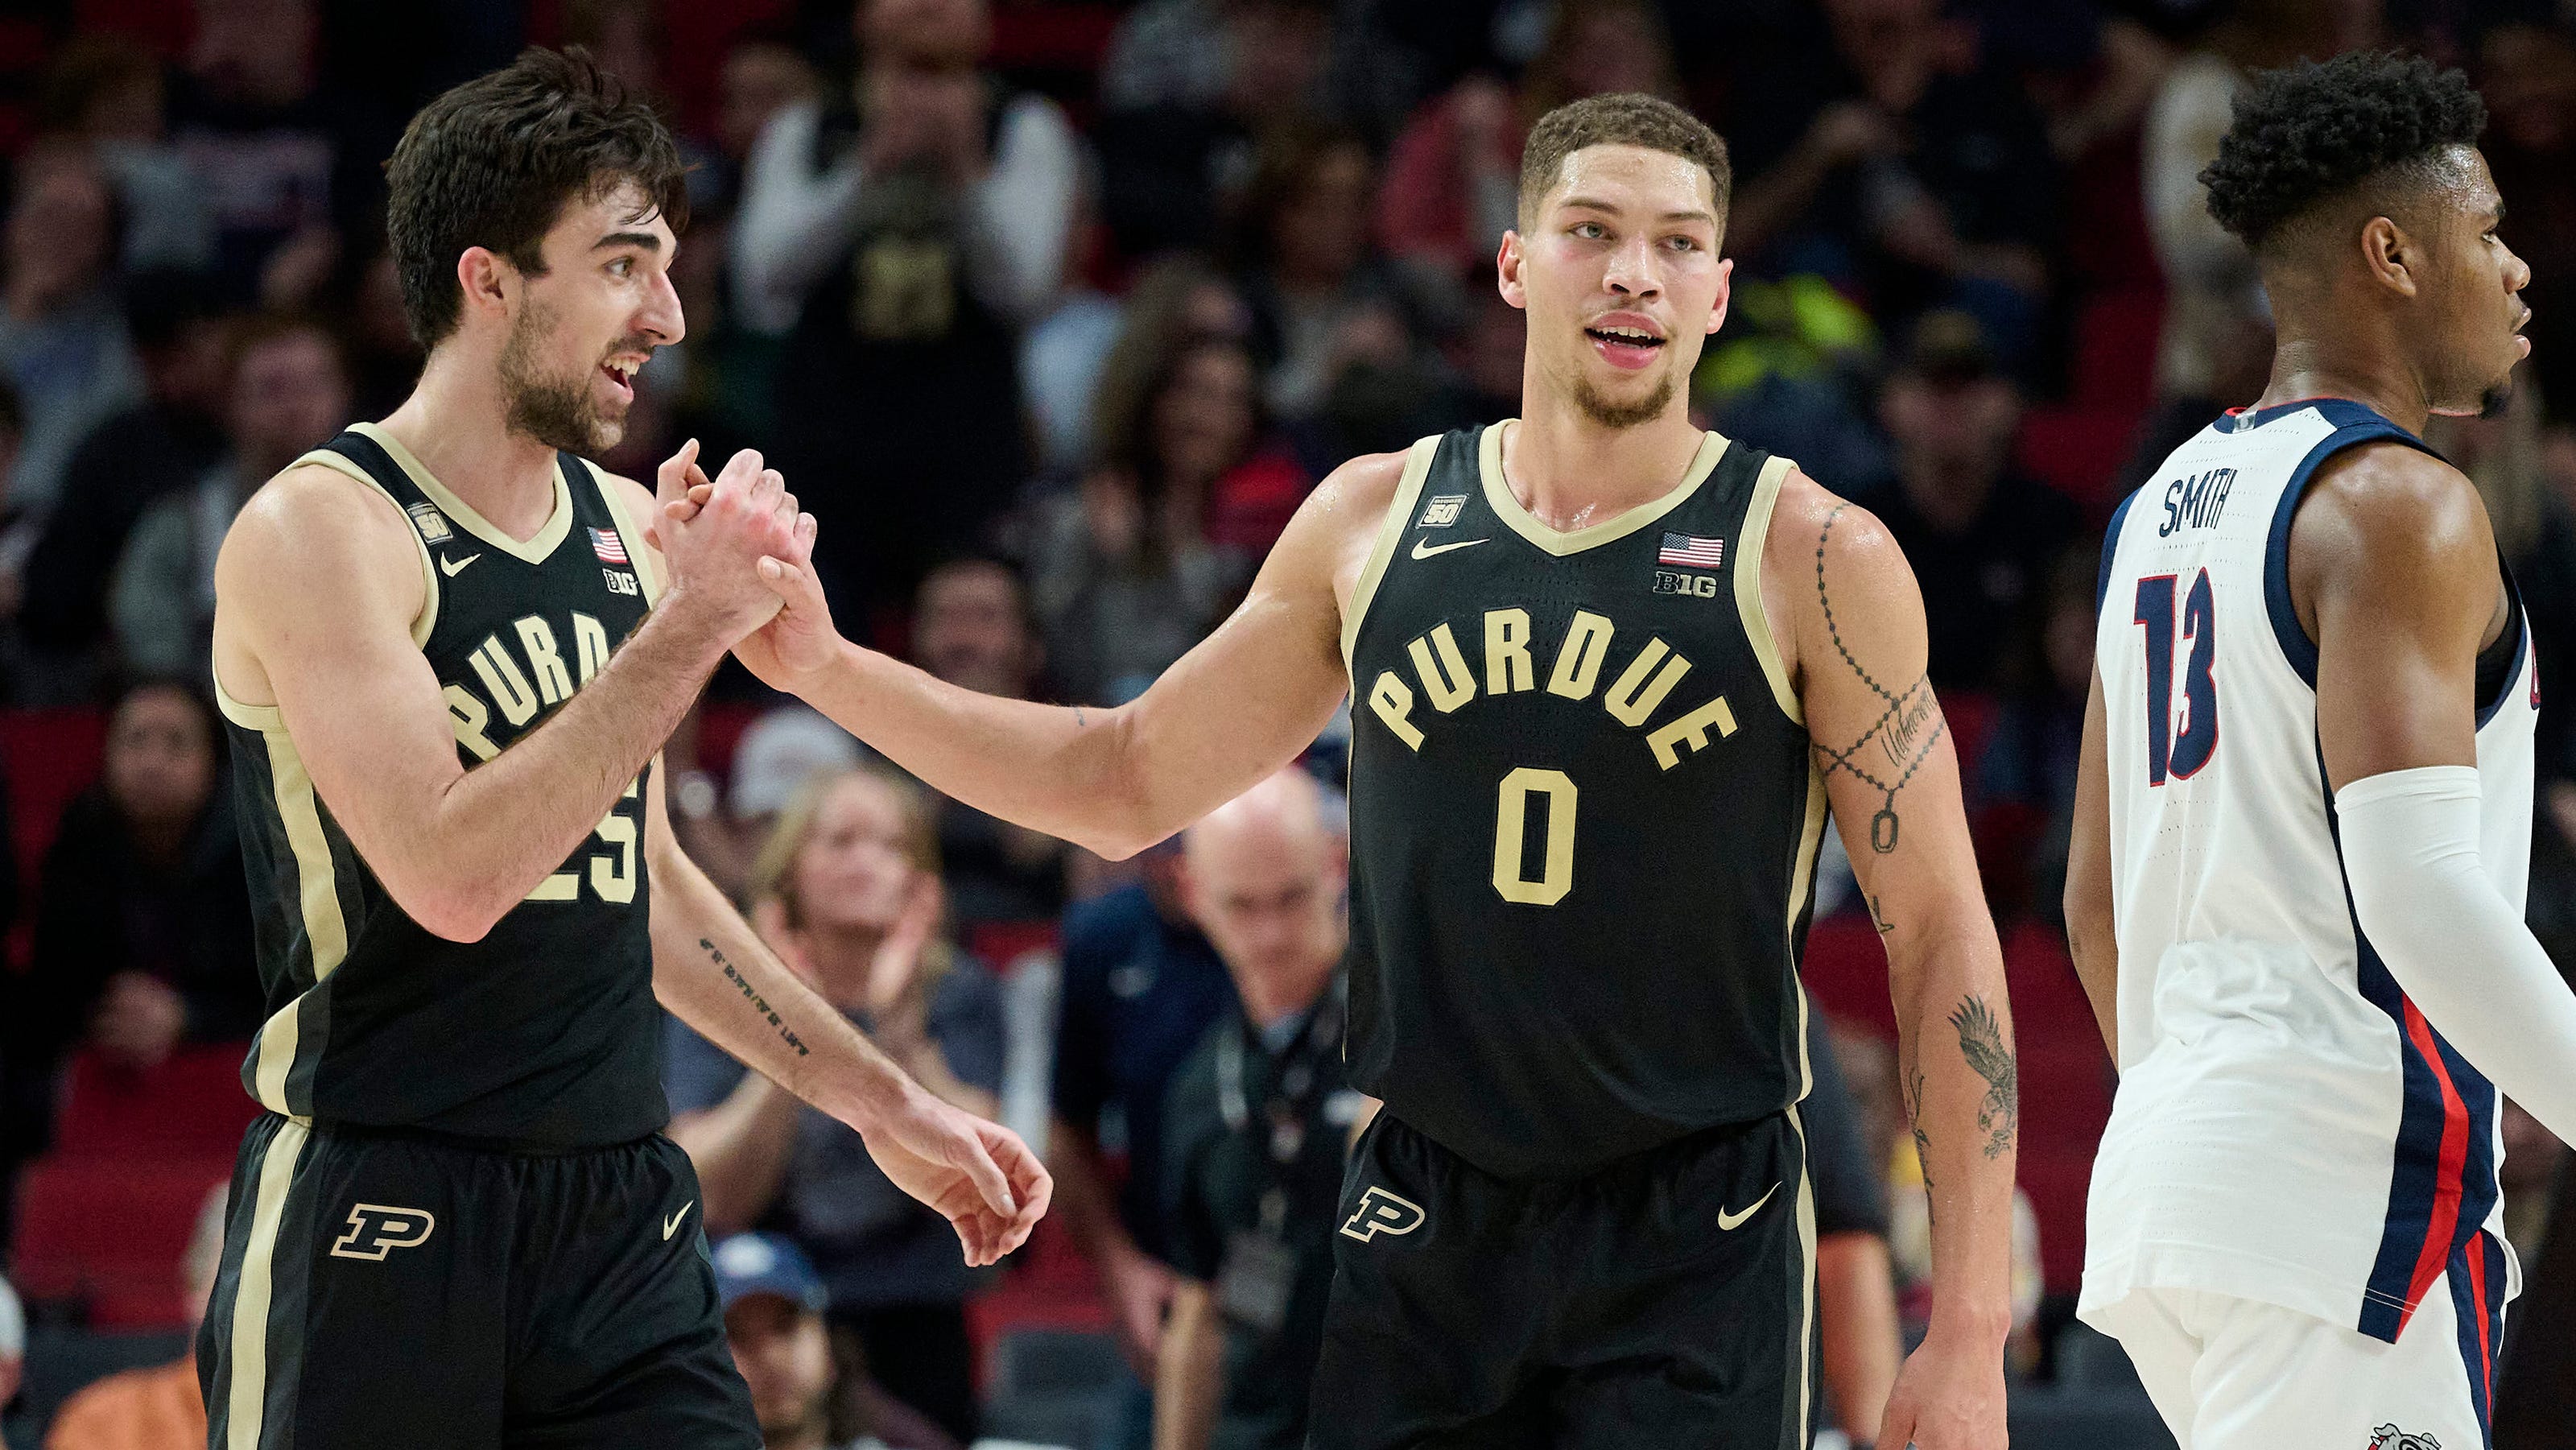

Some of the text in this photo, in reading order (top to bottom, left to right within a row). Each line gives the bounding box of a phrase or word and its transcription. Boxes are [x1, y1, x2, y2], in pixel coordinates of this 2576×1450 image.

[1424, 503, 1459, 523] 50
[2159, 468, 2238, 538] SMITH
[443, 613, 610, 763] PURD
[1368, 607, 1739, 772] PURDUE
[2133, 567, 2219, 787] 13
[1492, 766, 1578, 907] 0
[330, 1203, 435, 1262] P
[1340, 1185, 1426, 1243] P
